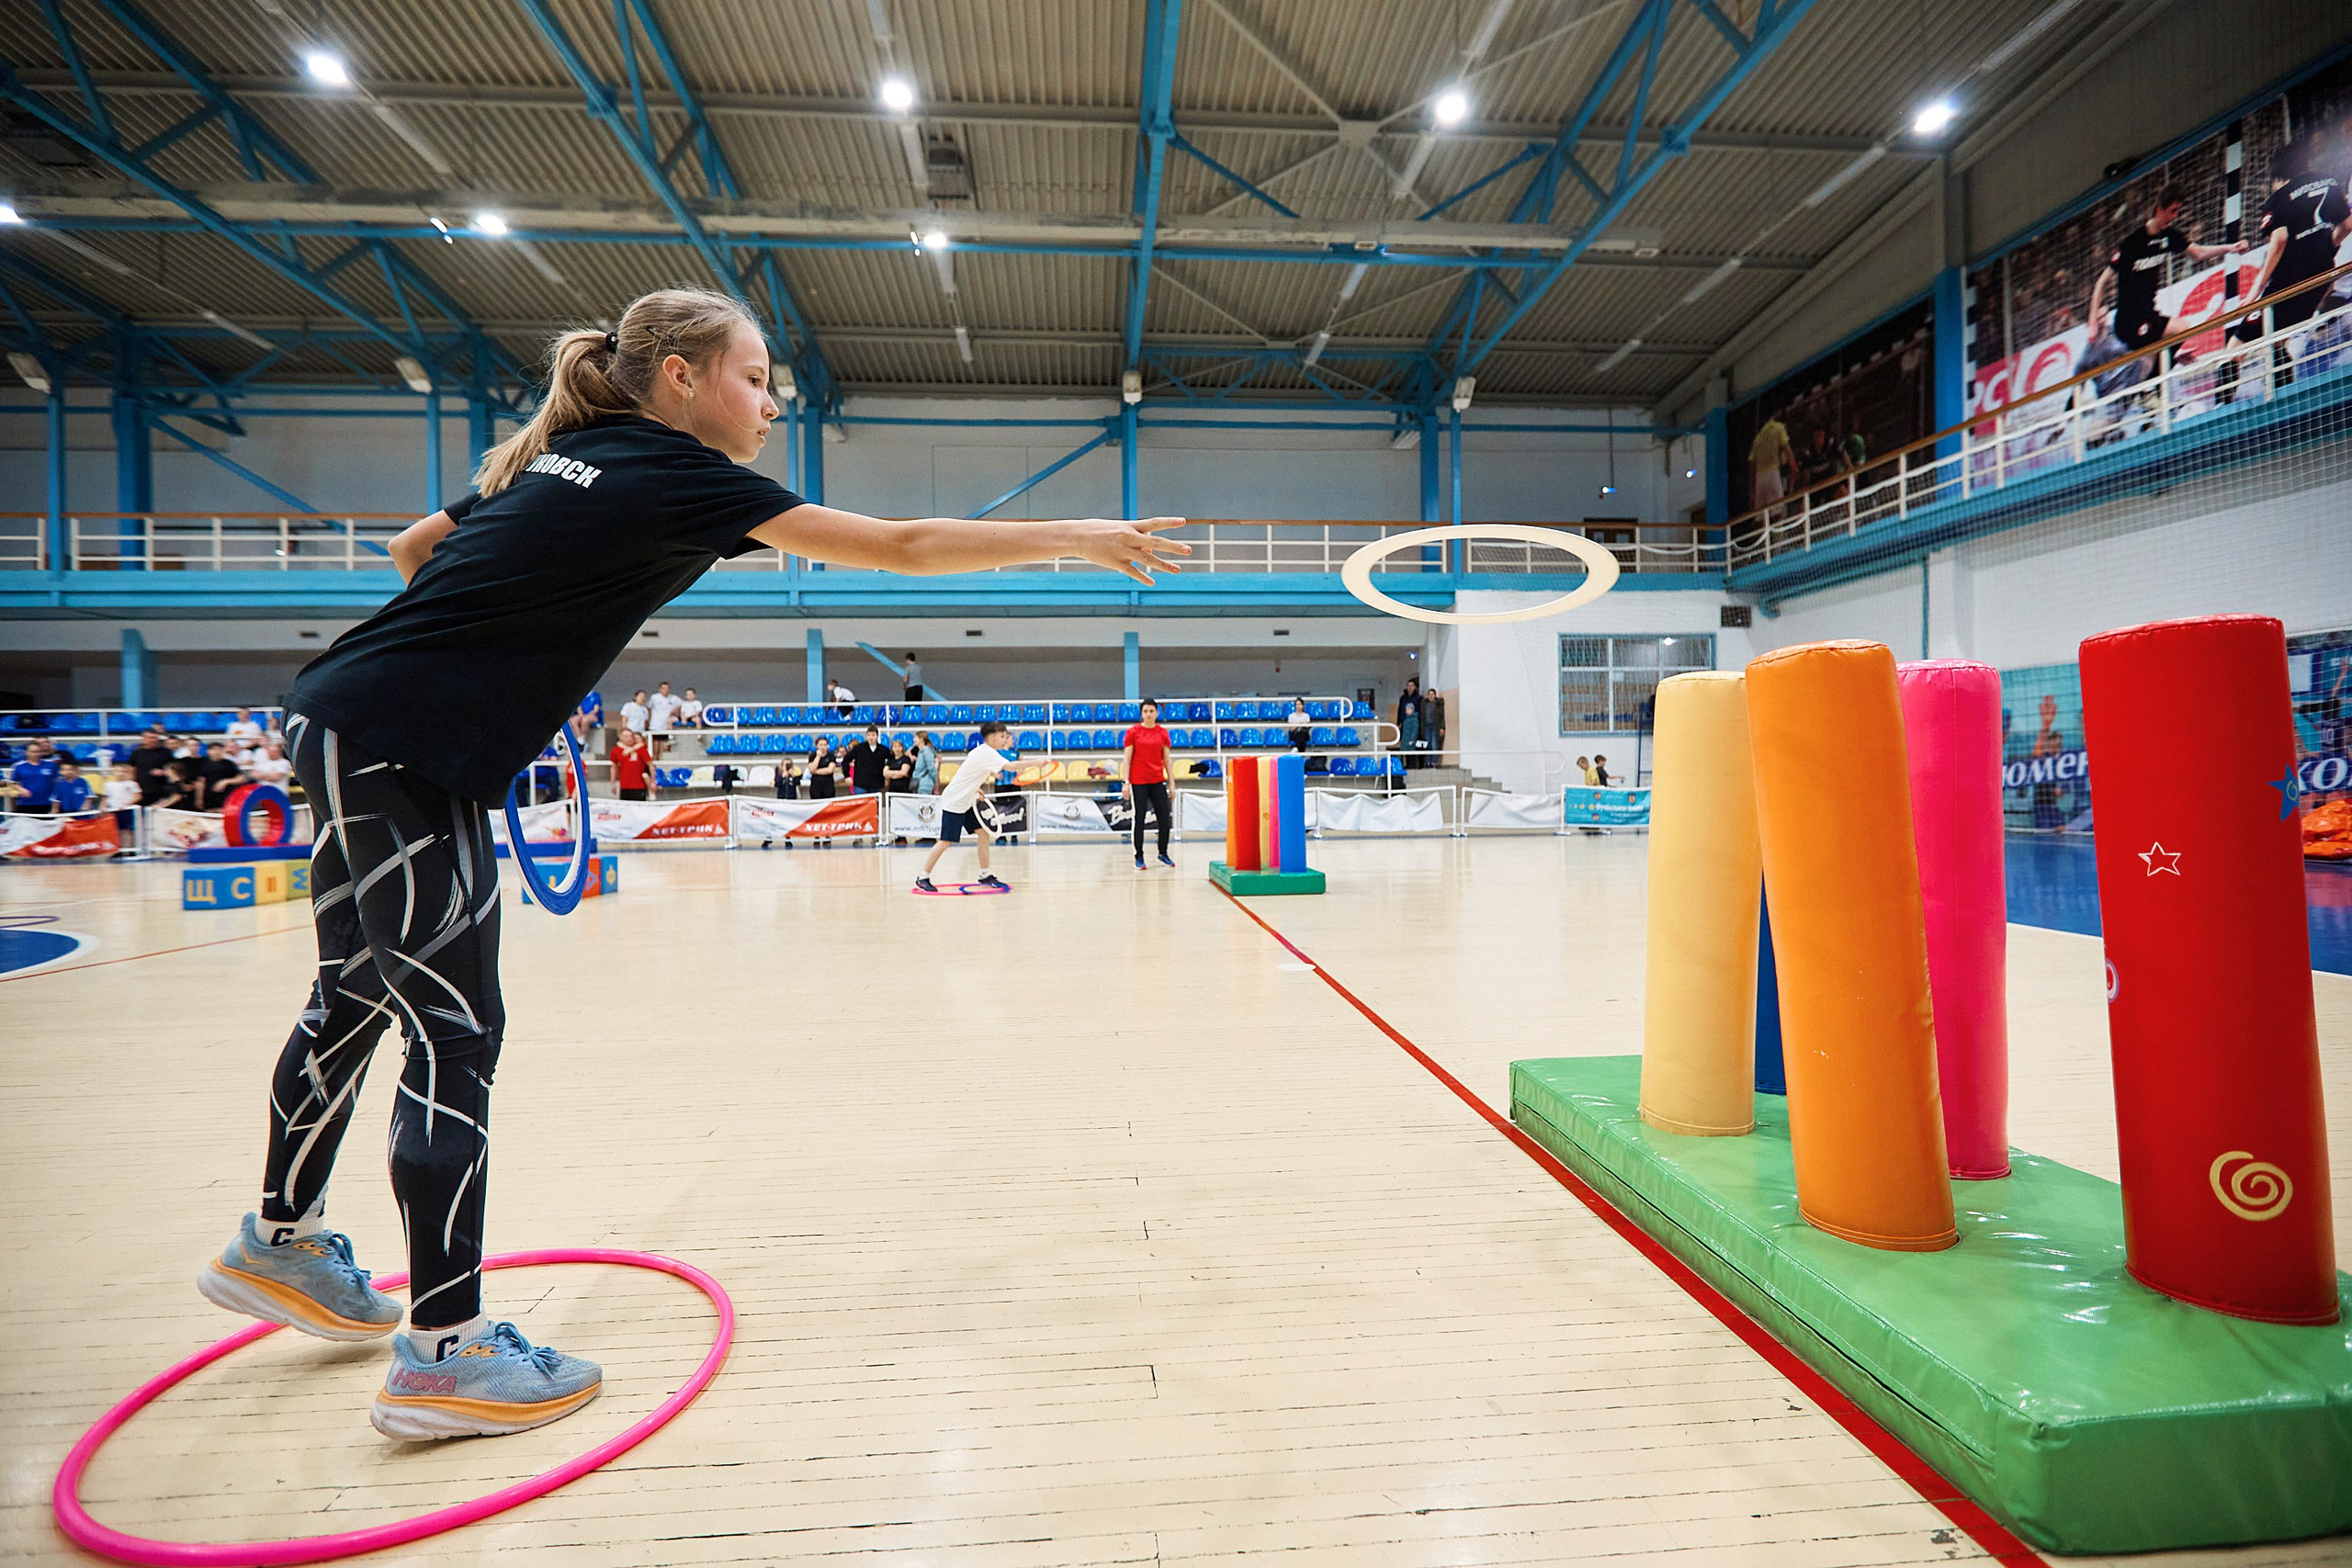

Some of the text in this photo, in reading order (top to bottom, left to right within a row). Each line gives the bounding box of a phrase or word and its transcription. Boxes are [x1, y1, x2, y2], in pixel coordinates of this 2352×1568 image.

[2307, 186, 2329, 225] 7
[186, 879, 217, 904] Щ
[270, 1227, 295, 1247] C
[435, 1334, 460, 1363] C
[391, 1367, 458, 1393] HOKA
